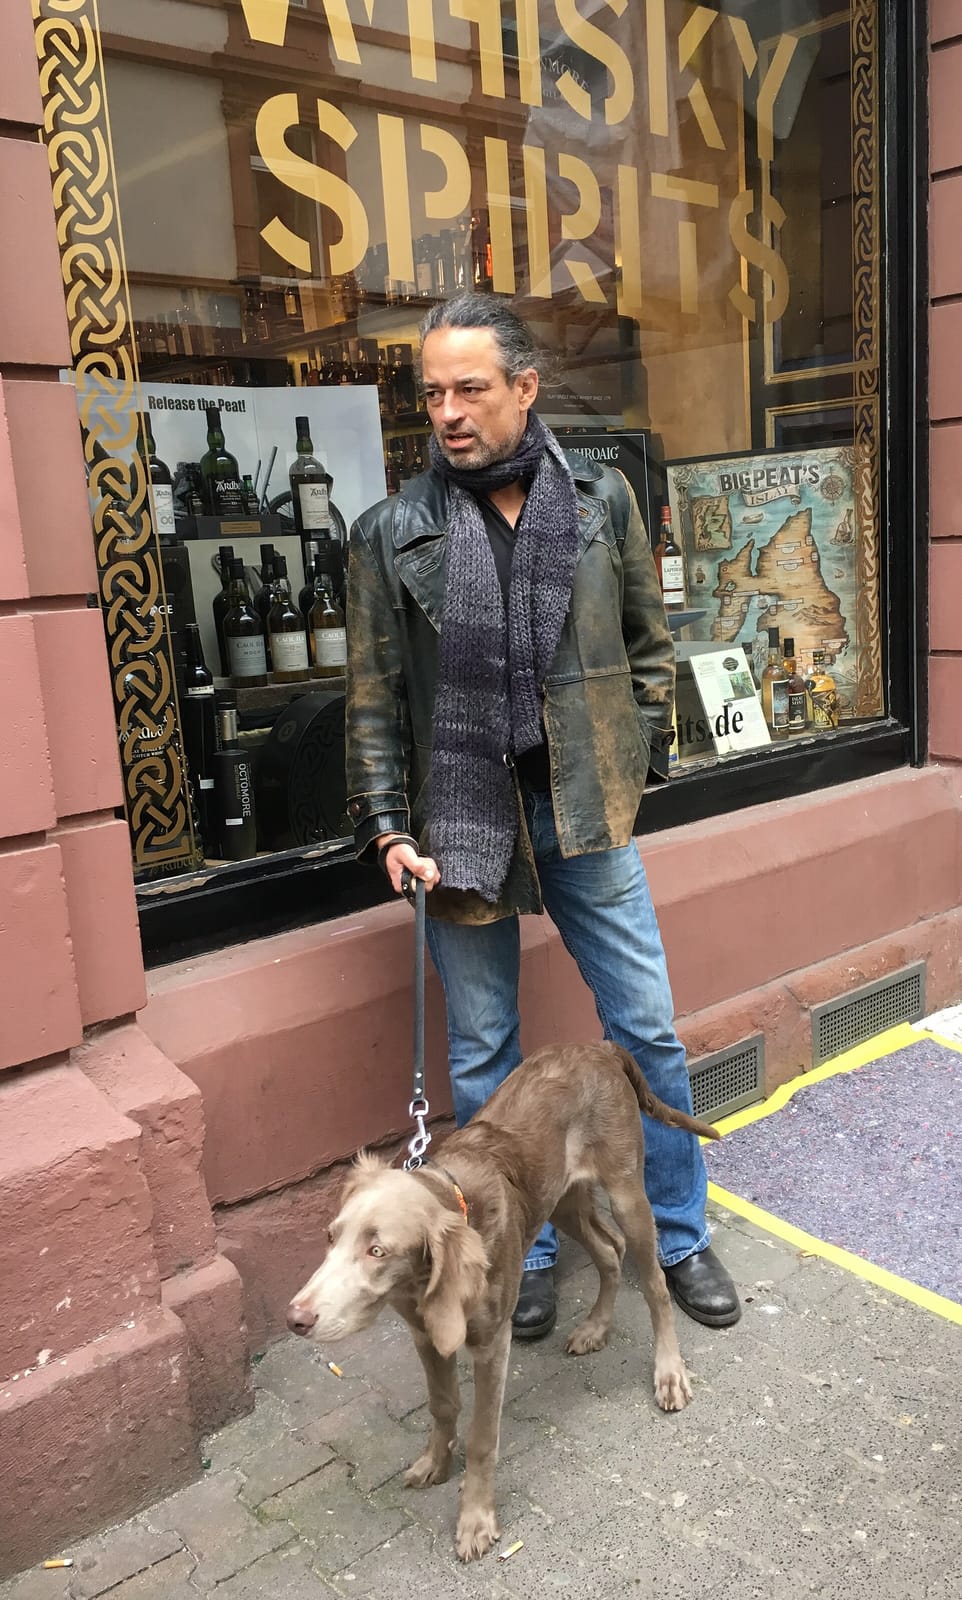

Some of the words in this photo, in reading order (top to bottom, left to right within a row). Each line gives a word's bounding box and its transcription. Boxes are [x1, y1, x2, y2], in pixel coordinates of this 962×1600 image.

[255, 92, 789, 326] SPIRITS
[148, 395, 195, 412] Release
[218, 398, 246, 413] Peat!
[720, 473, 751, 492] BIG
[753, 464, 820, 488] PEAT'S
[750, 486, 789, 506] ISLAY
[238, 762, 251, 818] OCTOMORE
